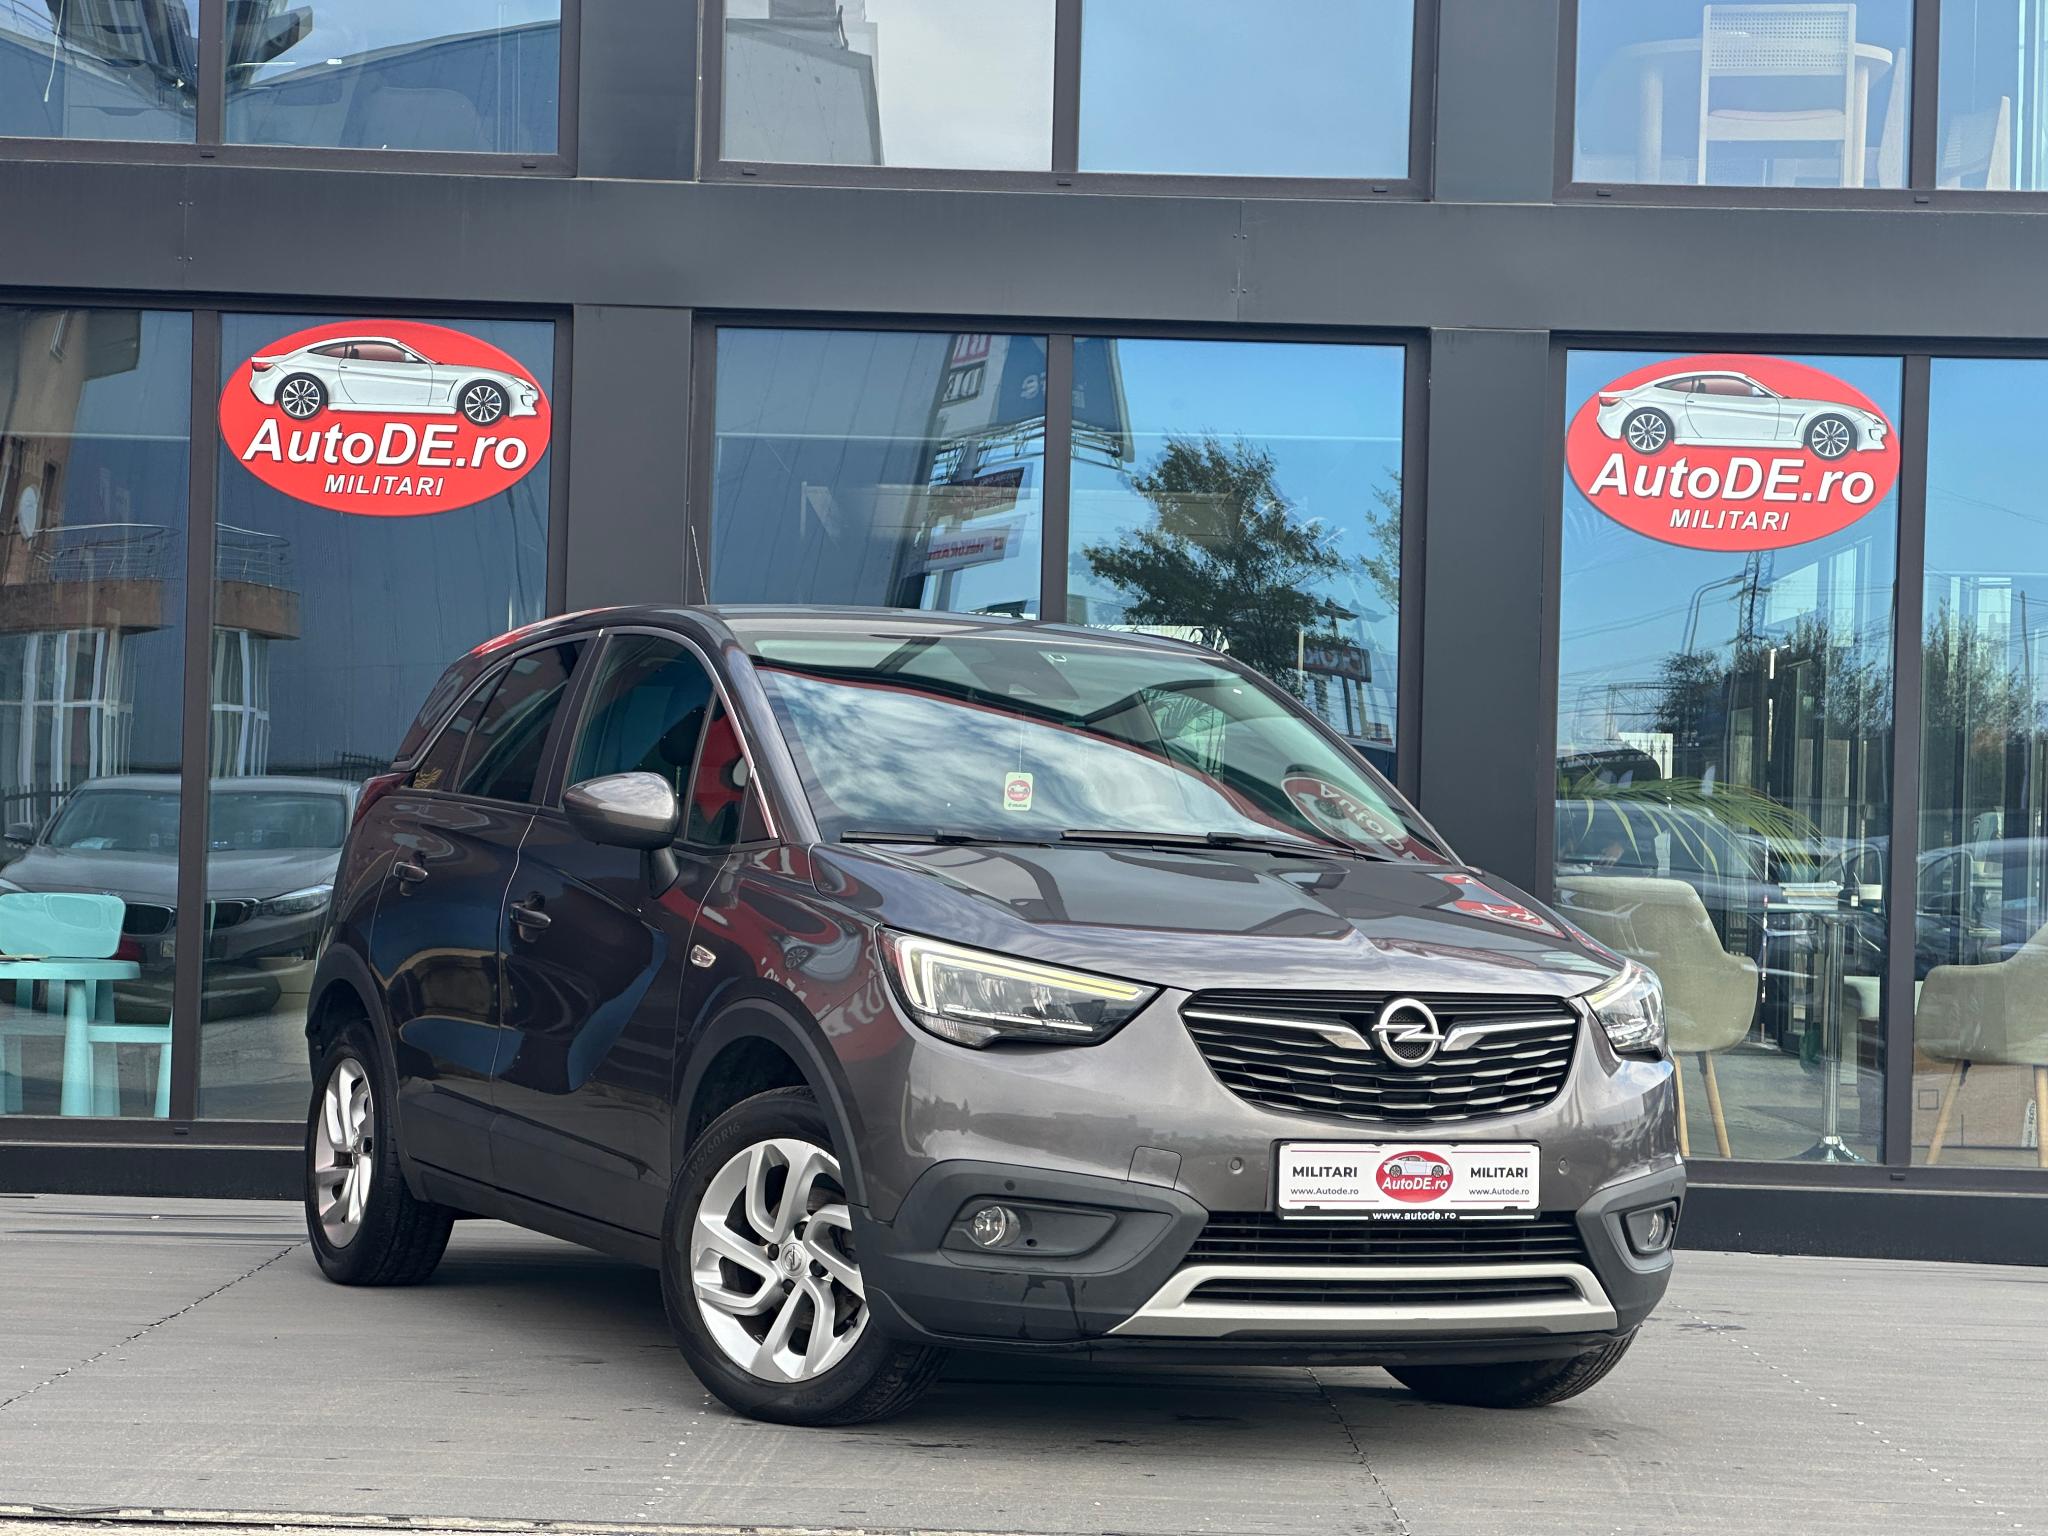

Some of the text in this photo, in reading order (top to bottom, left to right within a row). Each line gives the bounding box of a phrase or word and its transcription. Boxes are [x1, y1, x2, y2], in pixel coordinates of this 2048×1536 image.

[241, 418, 528, 470] AutoDE.ro
[1588, 453, 1875, 504] AutoDE.ro
[324, 474, 445, 496] MILITARI
[1669, 509, 1790, 531] MILITARI
[1292, 1166, 1358, 1178] MILITARI
[1470, 1167, 1528, 1178] MILITARI
[1382, 1177, 1448, 1190] AutoDE.ro
[1290, 1187, 1359, 1195] www.Autode.ro
[1468, 1187, 1530, 1195] www.Autode.ro
[1372, 1210, 1457, 1220] www.autode.ro
